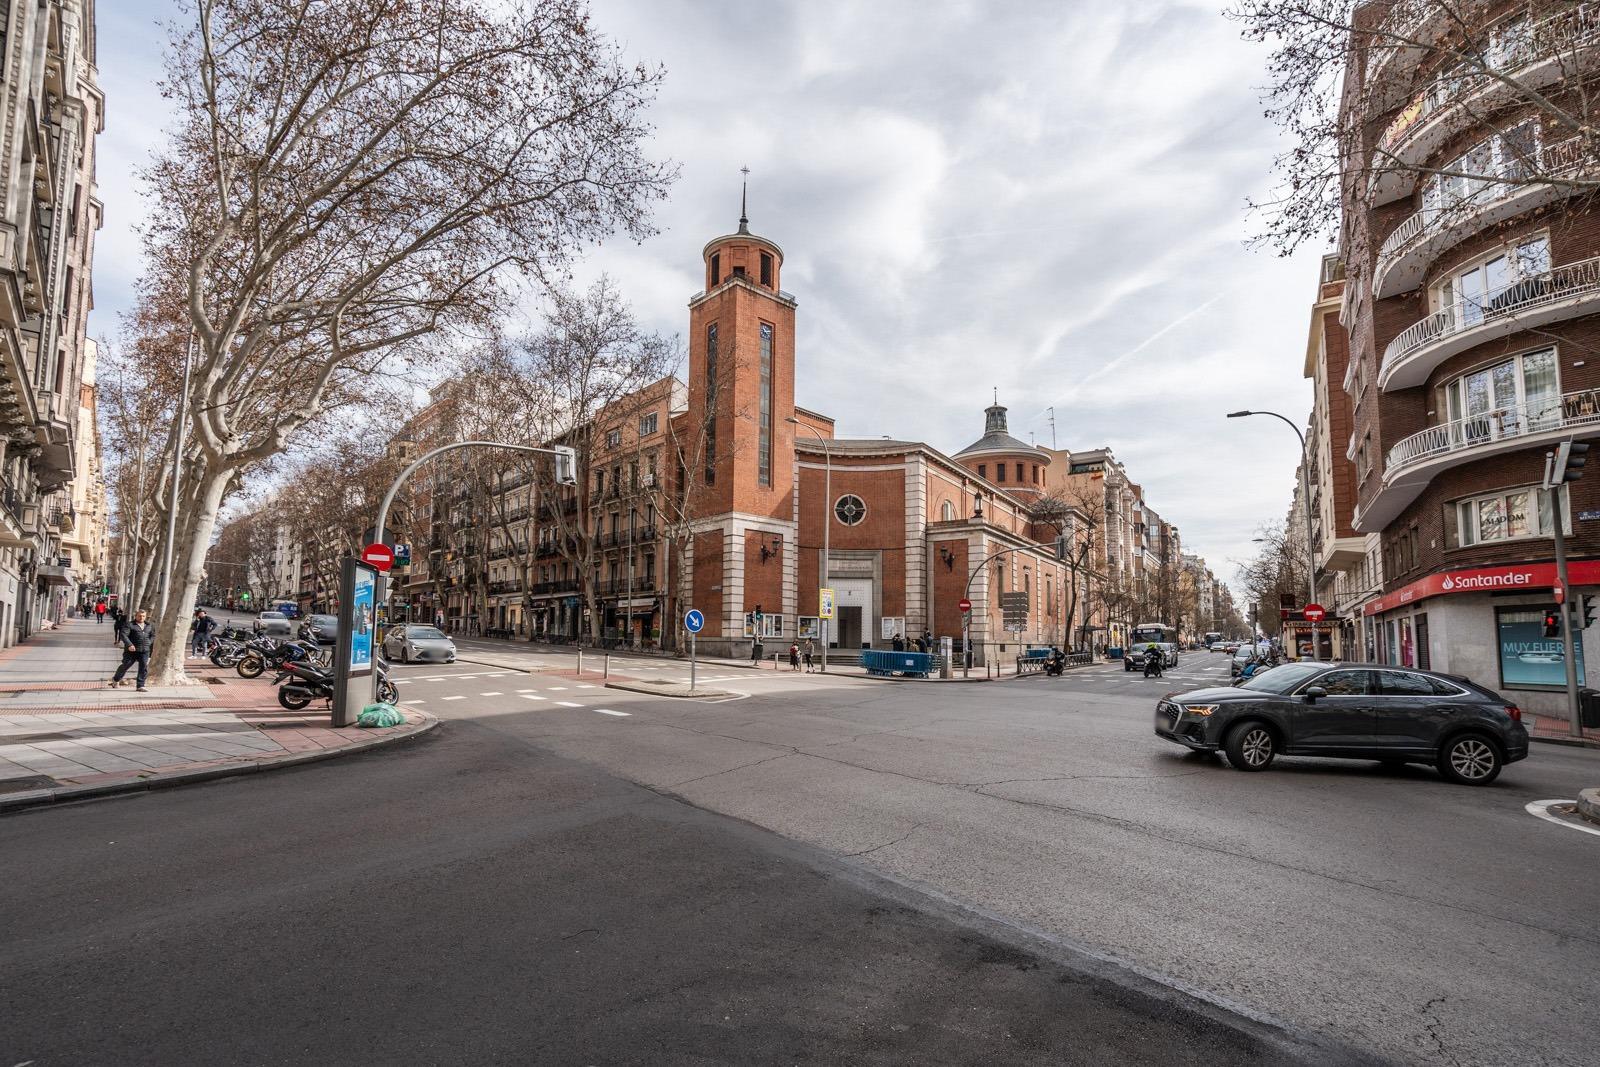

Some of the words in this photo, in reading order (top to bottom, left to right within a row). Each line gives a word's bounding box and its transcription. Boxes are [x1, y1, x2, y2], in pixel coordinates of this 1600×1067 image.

[1455, 572, 1533, 589] Santander
[1503, 642, 1530, 653] MUY
[1533, 641, 1580, 653] FUERE
